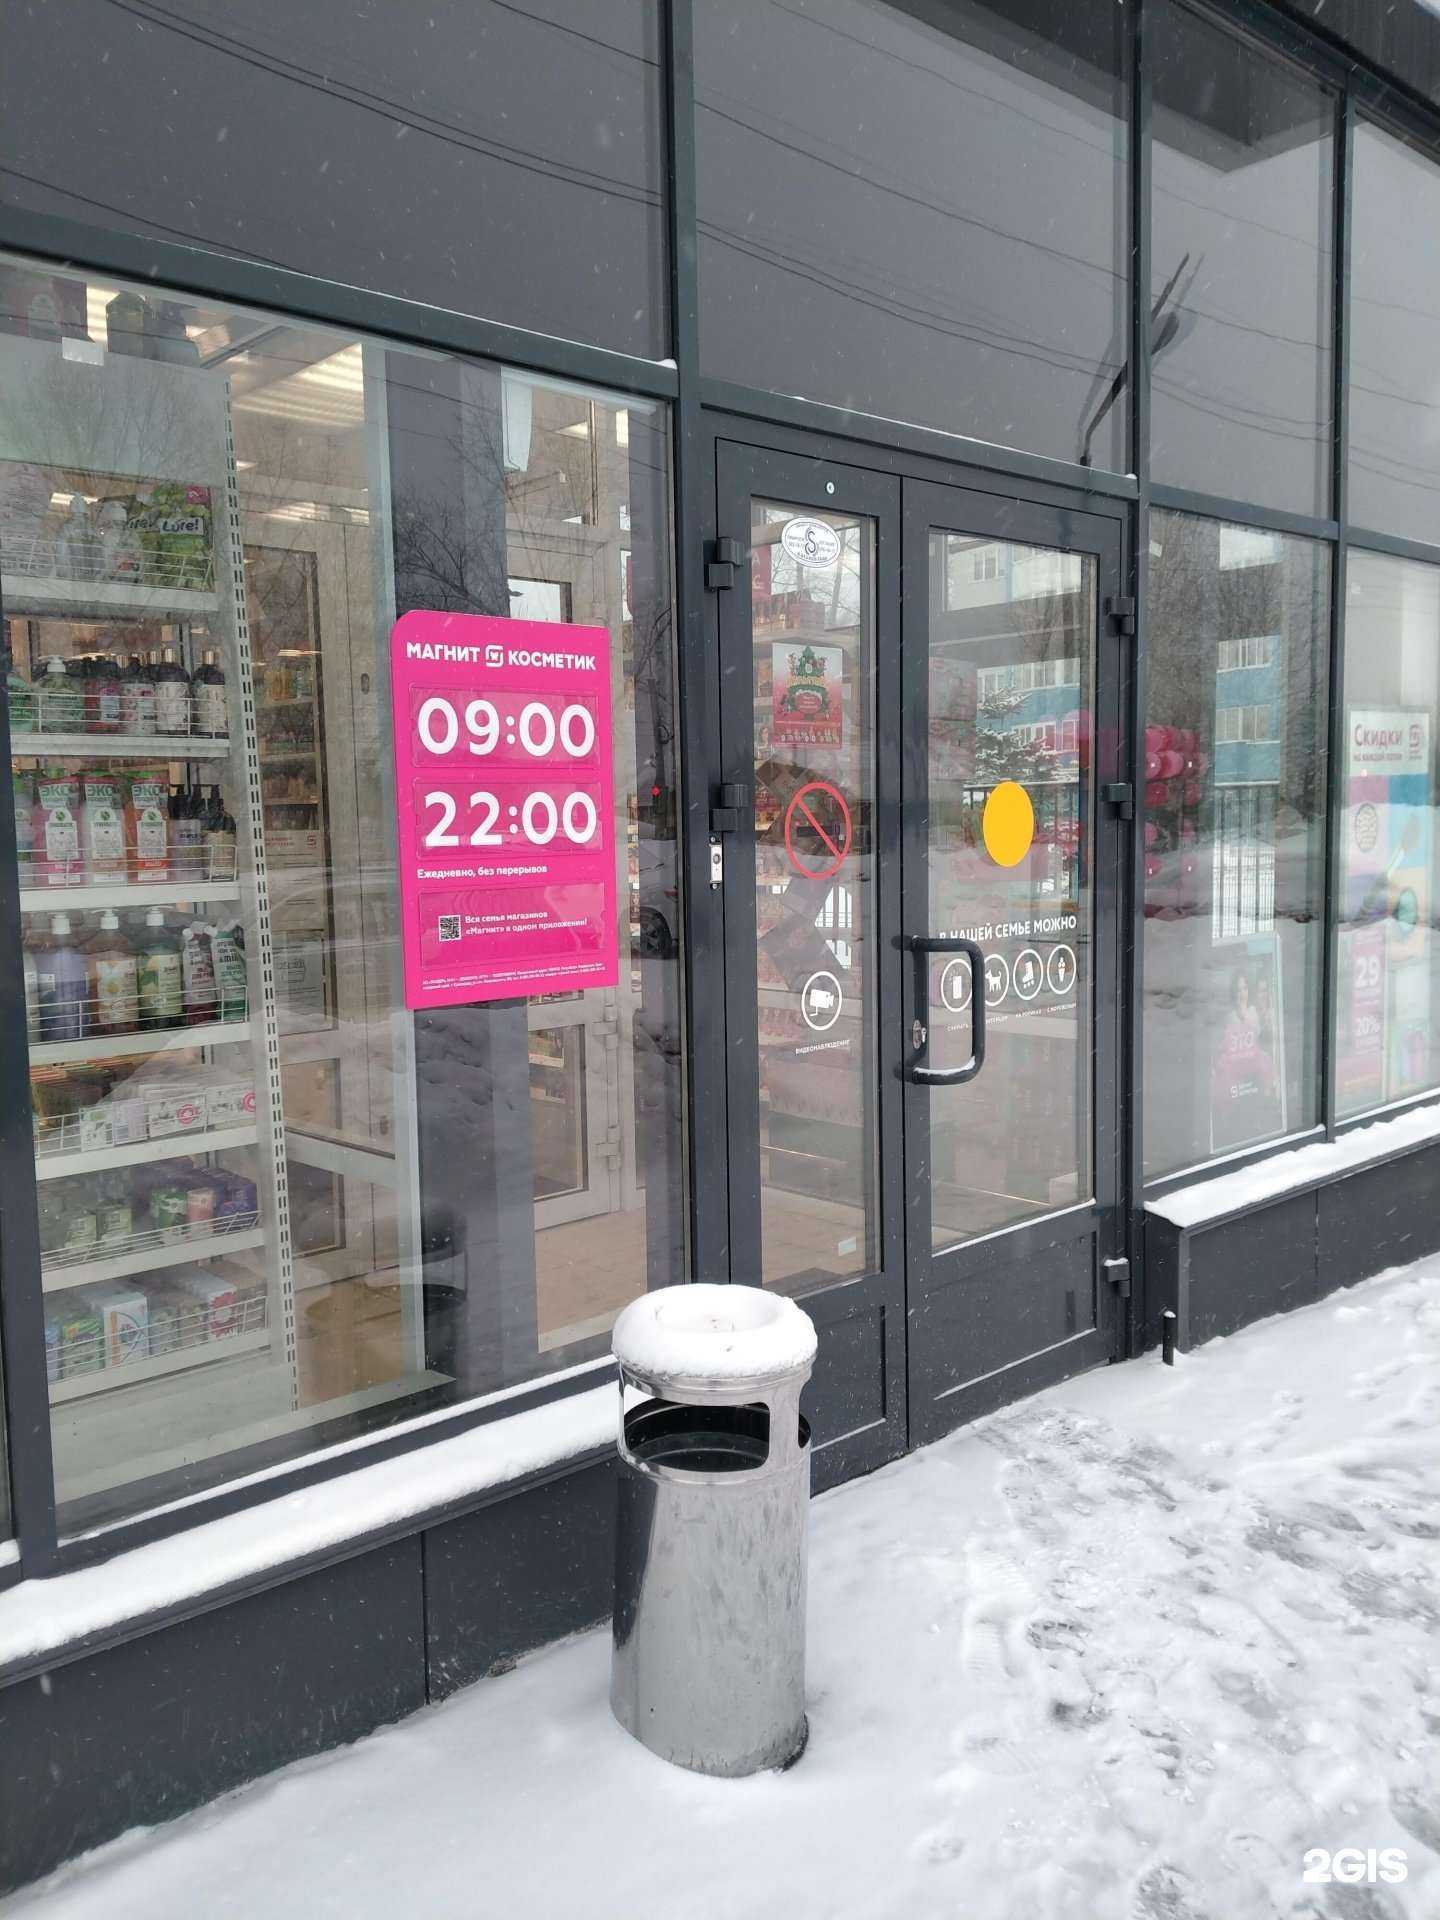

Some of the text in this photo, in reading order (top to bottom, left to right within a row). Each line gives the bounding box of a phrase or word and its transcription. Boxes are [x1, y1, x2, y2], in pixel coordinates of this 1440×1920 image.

[406, 641, 596, 671] МАГНИТ КОСМЕТИК
[417, 697, 595, 758] 09:00
[1354, 723, 1403, 750] Скидки
[424, 791, 597, 847] 22:00
[416, 864, 548, 880] Ежедневно, без перерывов
[464, 911, 548, 924] Вся семья магазинов
[512, 922, 537, 934] одном
[538, 917, 588, 931] приложении!
[950, 923, 993, 943] НАШЕЙ
[995, 920, 1031, 938] СЕМЬЕ
[1033, 915, 1077, 934] МОЖНО
[1354, 956, 1381, 988] 29
